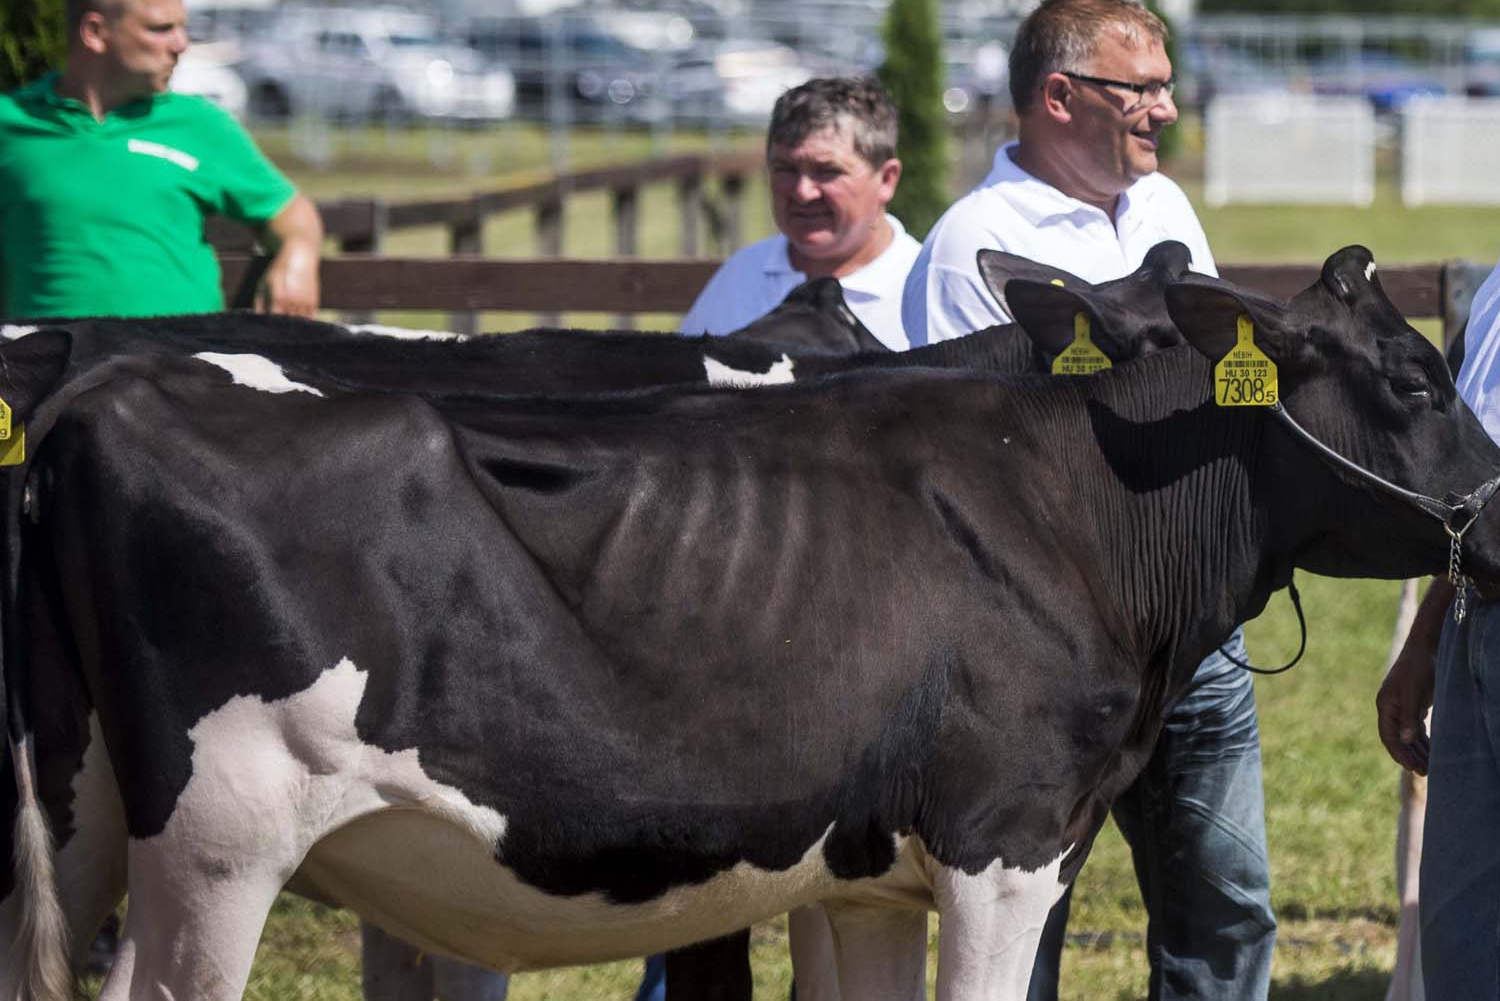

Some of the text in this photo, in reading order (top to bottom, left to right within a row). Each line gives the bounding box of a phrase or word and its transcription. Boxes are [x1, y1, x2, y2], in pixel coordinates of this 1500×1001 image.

[1225, 369, 1268, 378] HU 30 123
